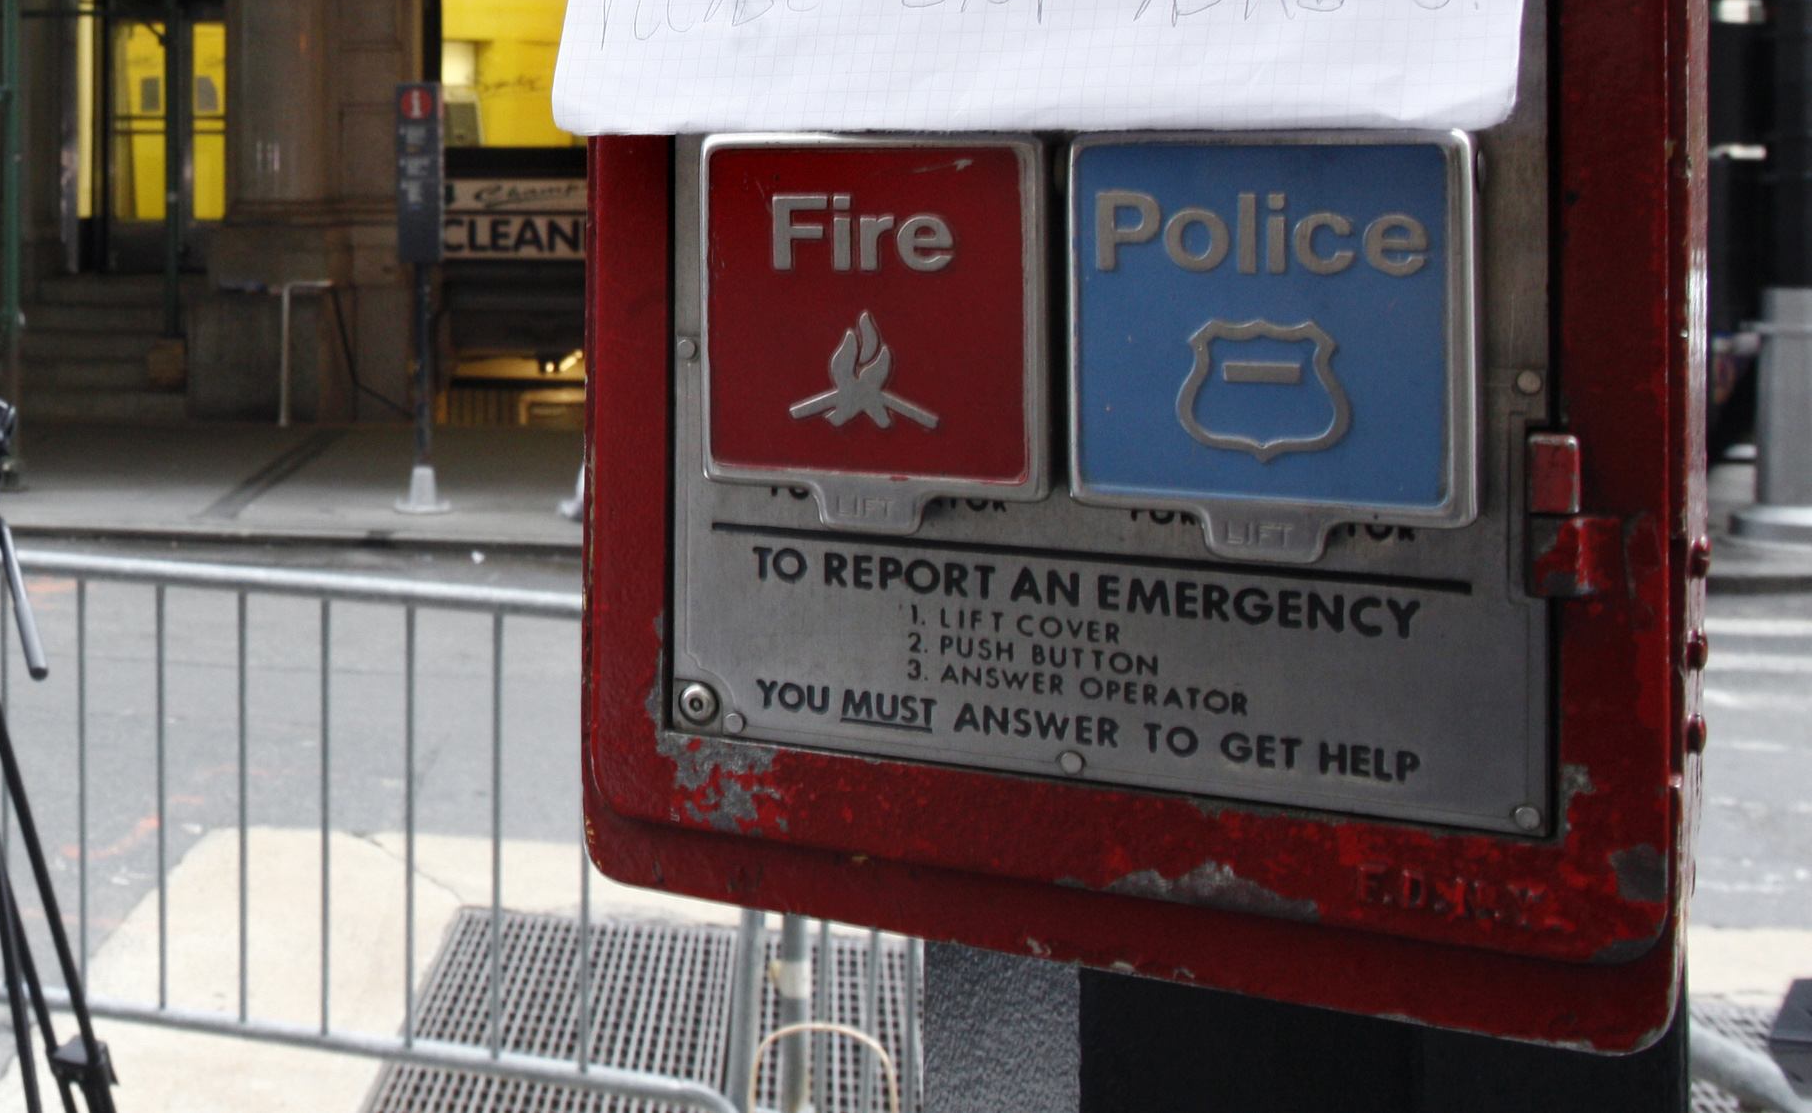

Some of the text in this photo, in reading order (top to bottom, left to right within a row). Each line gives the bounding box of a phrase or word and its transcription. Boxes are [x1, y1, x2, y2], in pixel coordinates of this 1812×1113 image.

[444, 218, 586, 253] CLEAN
[770, 191, 955, 273] Fire
[1094, 190, 1430, 277] Police
[835, 493, 894, 518] LIFT
[1225, 518, 1294, 547] LIFT
[752, 545, 1422, 641] TO REPORT AN EMERGENCY
[910, 604, 1121, 645] 1. LIFT COVER
[907, 632, 1160, 677] 2. PUSH BUTTON
[907, 659, 1249, 718] 3. ANSWER OPERATOR
[755, 678, 1422, 783] YOU MUST ANSWER TO GET HELP
